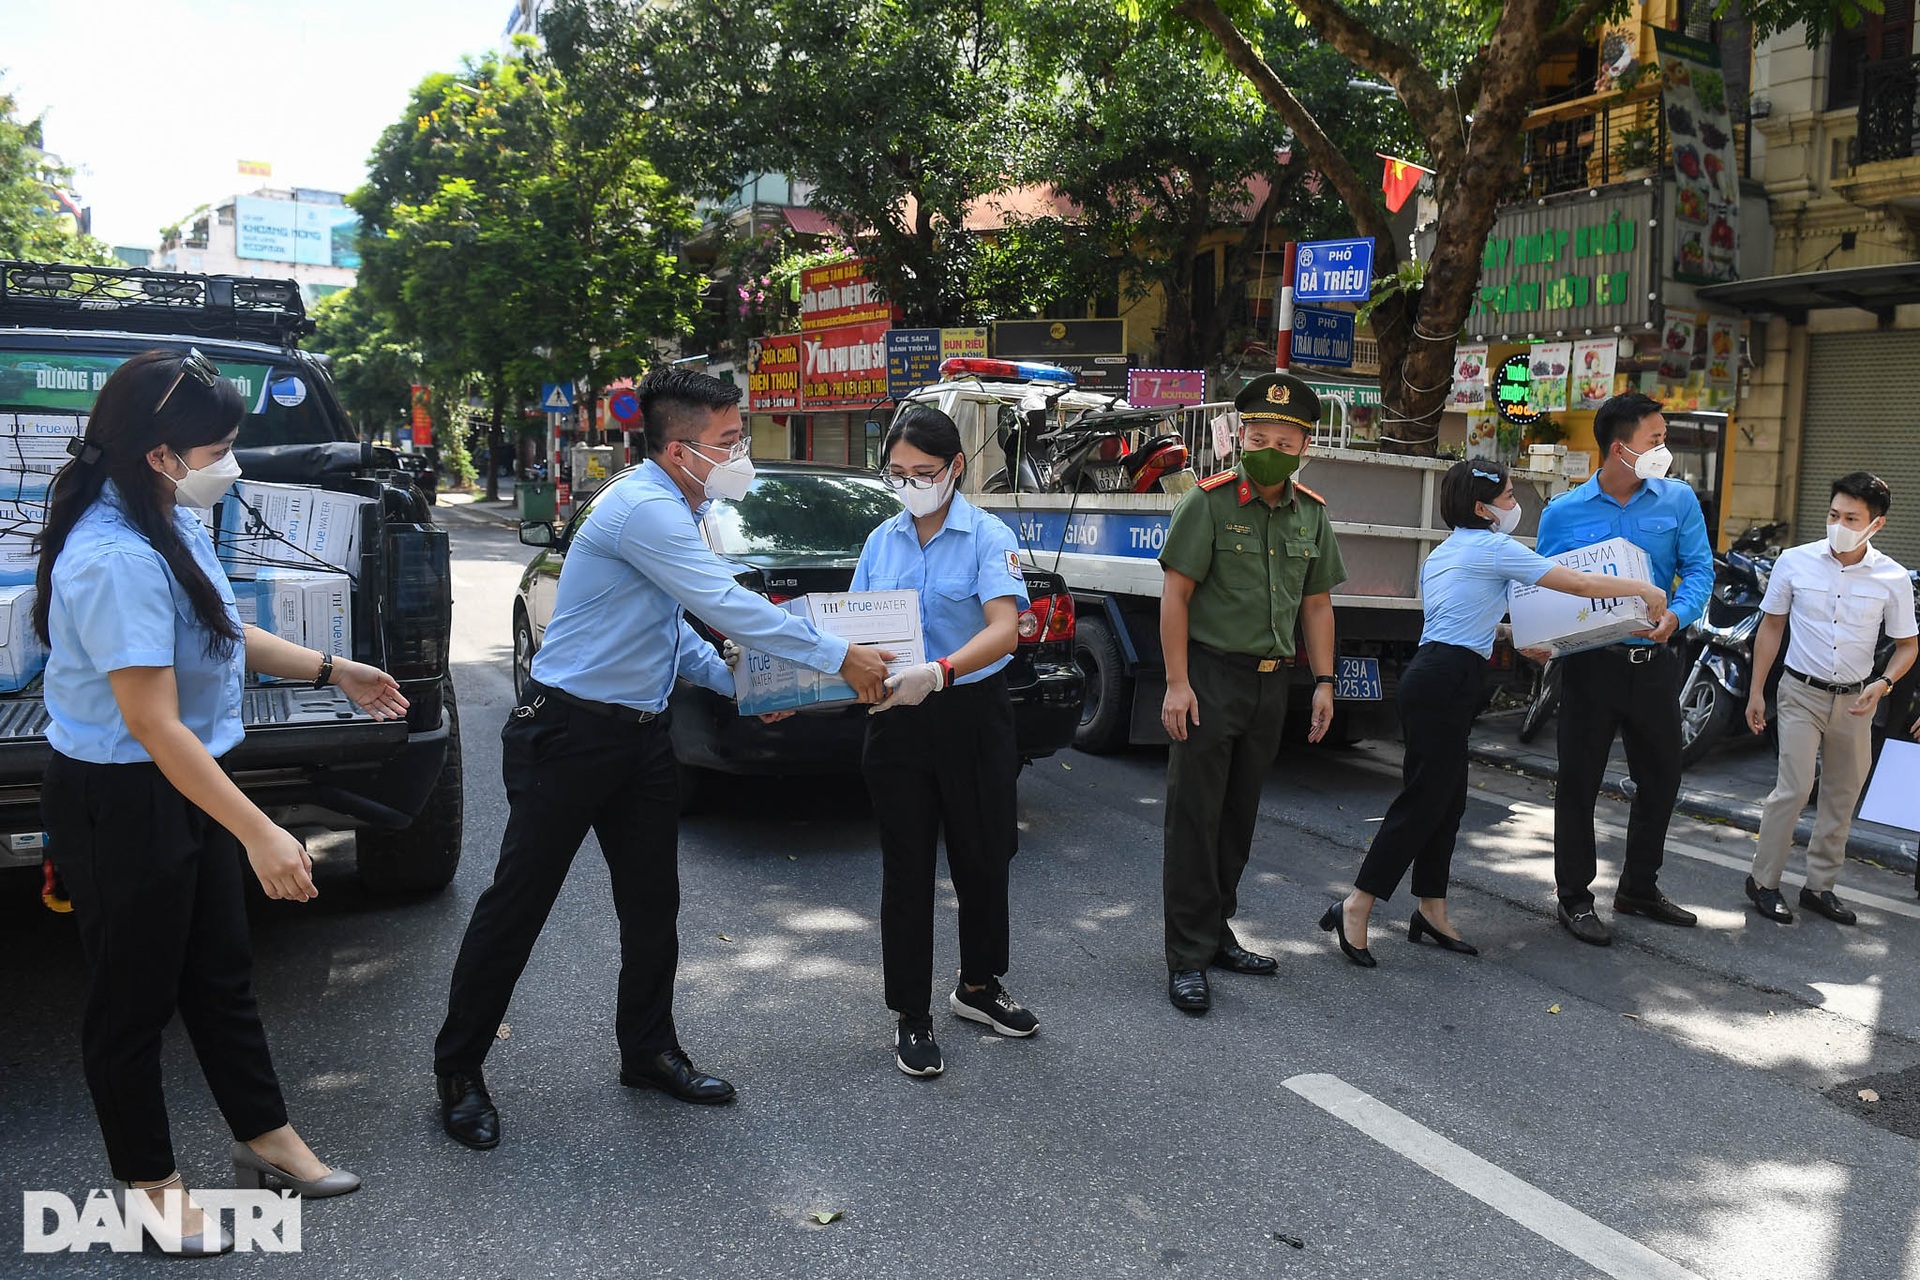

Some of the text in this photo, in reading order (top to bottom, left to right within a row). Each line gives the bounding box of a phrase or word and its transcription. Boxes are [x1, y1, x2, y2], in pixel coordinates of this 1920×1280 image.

[1514, 227, 1568, 270] NHẬP
[1575, 210, 1635, 258] KHẨU
[1329, 245, 1354, 261] PHỐ
[1300, 266, 1364, 295] BÀ TRIỆU
[1596, 271, 1628, 306] CƠ
[841, 281, 862, 311] ĐIỆN
[1318, 316, 1338, 329] PHỐ
[762, 343, 797, 365] SỬA CHỮA
[1313, 332, 1331, 359] QUỐC
[1333, 333, 1349, 359] TOẢN
[830, 346, 849, 377] PHỤ
[849, 339, 872, 376] KIỆN
[36, 368, 88, 390] ĐƯỜNG
[750, 370, 797, 395] ĐIỆN THOẠI
[1161, 391, 1201, 399] BOUTIQUE
[1326, 387, 1355, 405] NGHỆ
[36, 424, 60, 434] true
[288, 520, 299, 540] true
[314, 502, 331, 551] true WATER
[1019, 518, 1168, 549] SÁT GIAO THÔ
[333, 592, 342, 607] TH
[821, 600, 907, 613] TH true WATER
[334, 616, 344, 638] true
[748, 652, 770, 673] true
[1343, 660, 1368, 678] 29A
[751, 673, 772, 687] WATER
